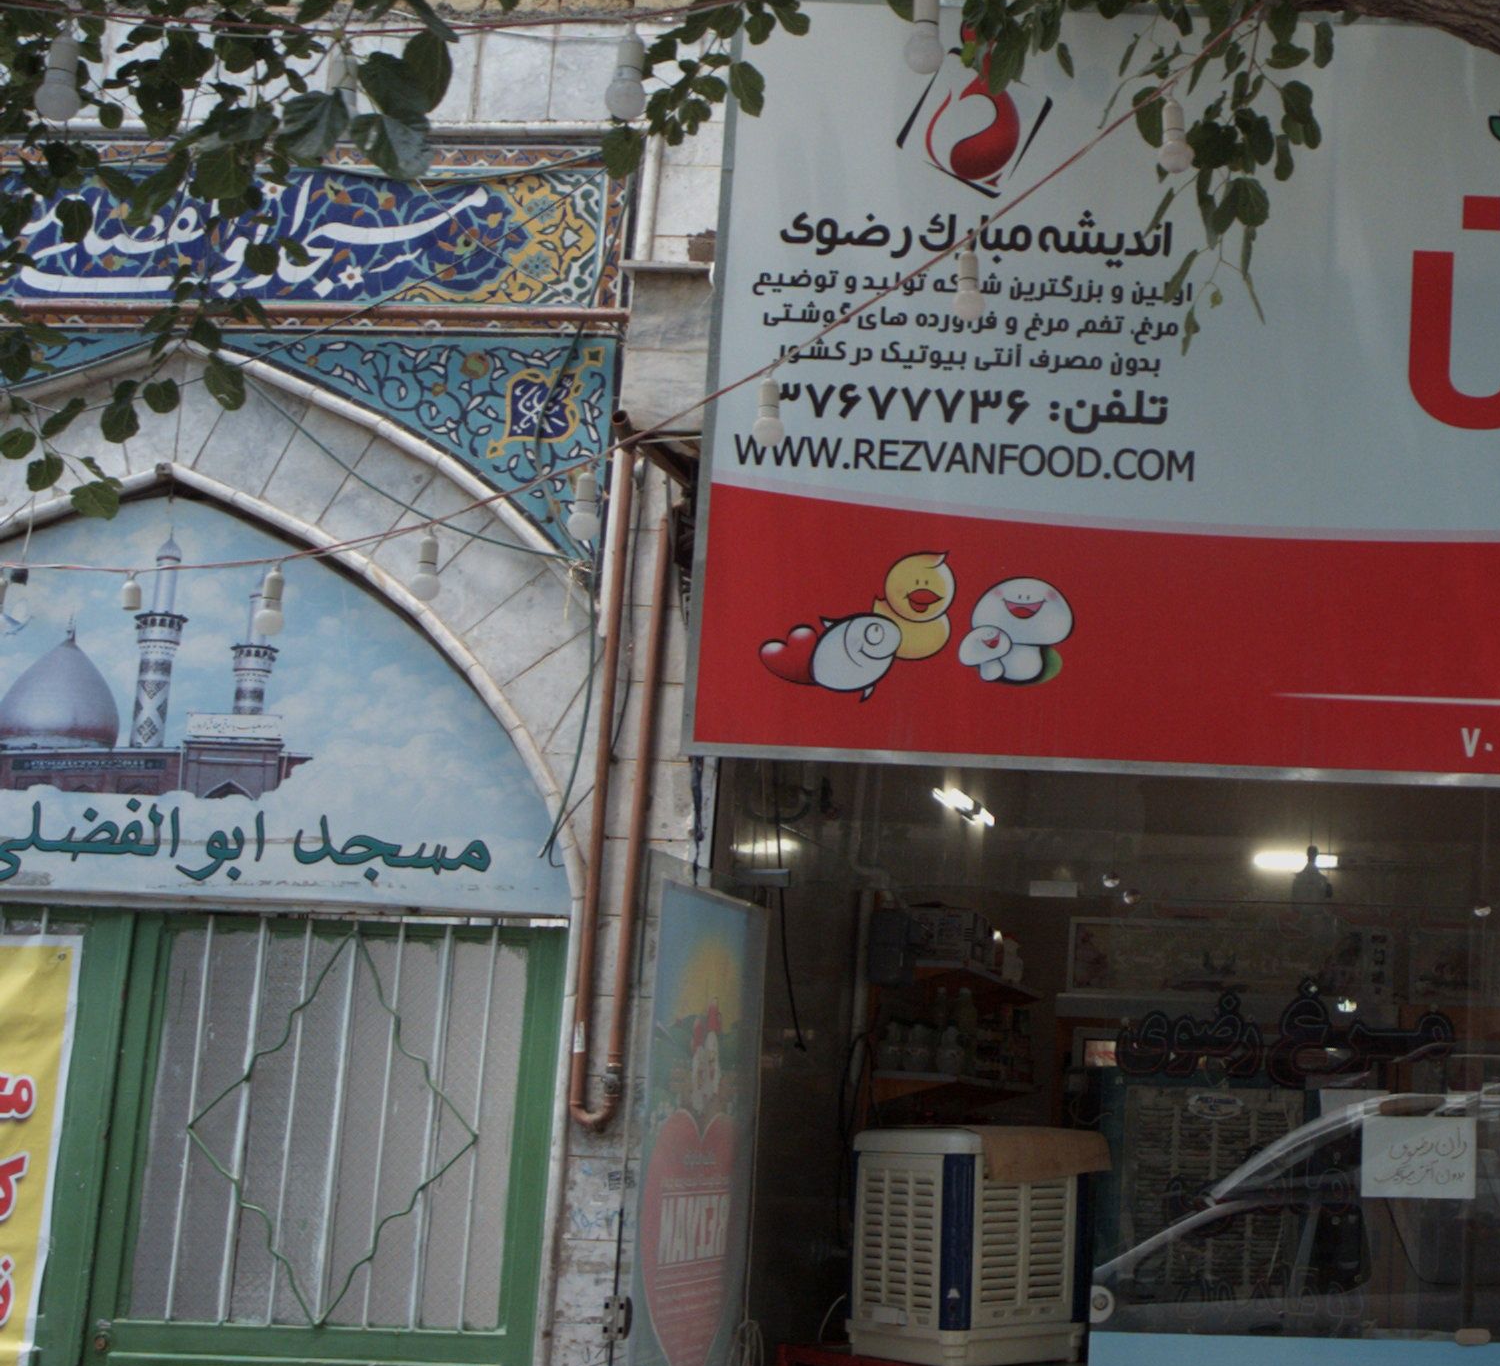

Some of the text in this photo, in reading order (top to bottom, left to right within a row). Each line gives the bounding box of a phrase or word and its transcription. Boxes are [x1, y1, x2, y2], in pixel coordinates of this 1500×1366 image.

[780, 211, 913, 259] رضوی
[1038, 210, 1173, 268] اندیشه
[844, 275, 857, 294] و
[863, 271, 928, 296] تولید
[1009, 275, 1103, 303] بزرگترین
[1111, 284, 1124, 304] و
[763, 301, 851, 328] گوشتی
[857, 306, 908, 330] های
[1005, 315, 1018, 335] و
[1024, 313, 1069, 341] مرغ
[1076, 315, 1125, 338] تخم
[849, 343, 873, 366] در
[880, 341, 967, 371] بیوتیک
[1029, 349, 1103, 374] مصرف
[1110, 351, 1161, 378] بدون
[734, 433, 1196, 482] WWW.REZVANFOOD.COM
[294, 814, 491, 882] مسجد
